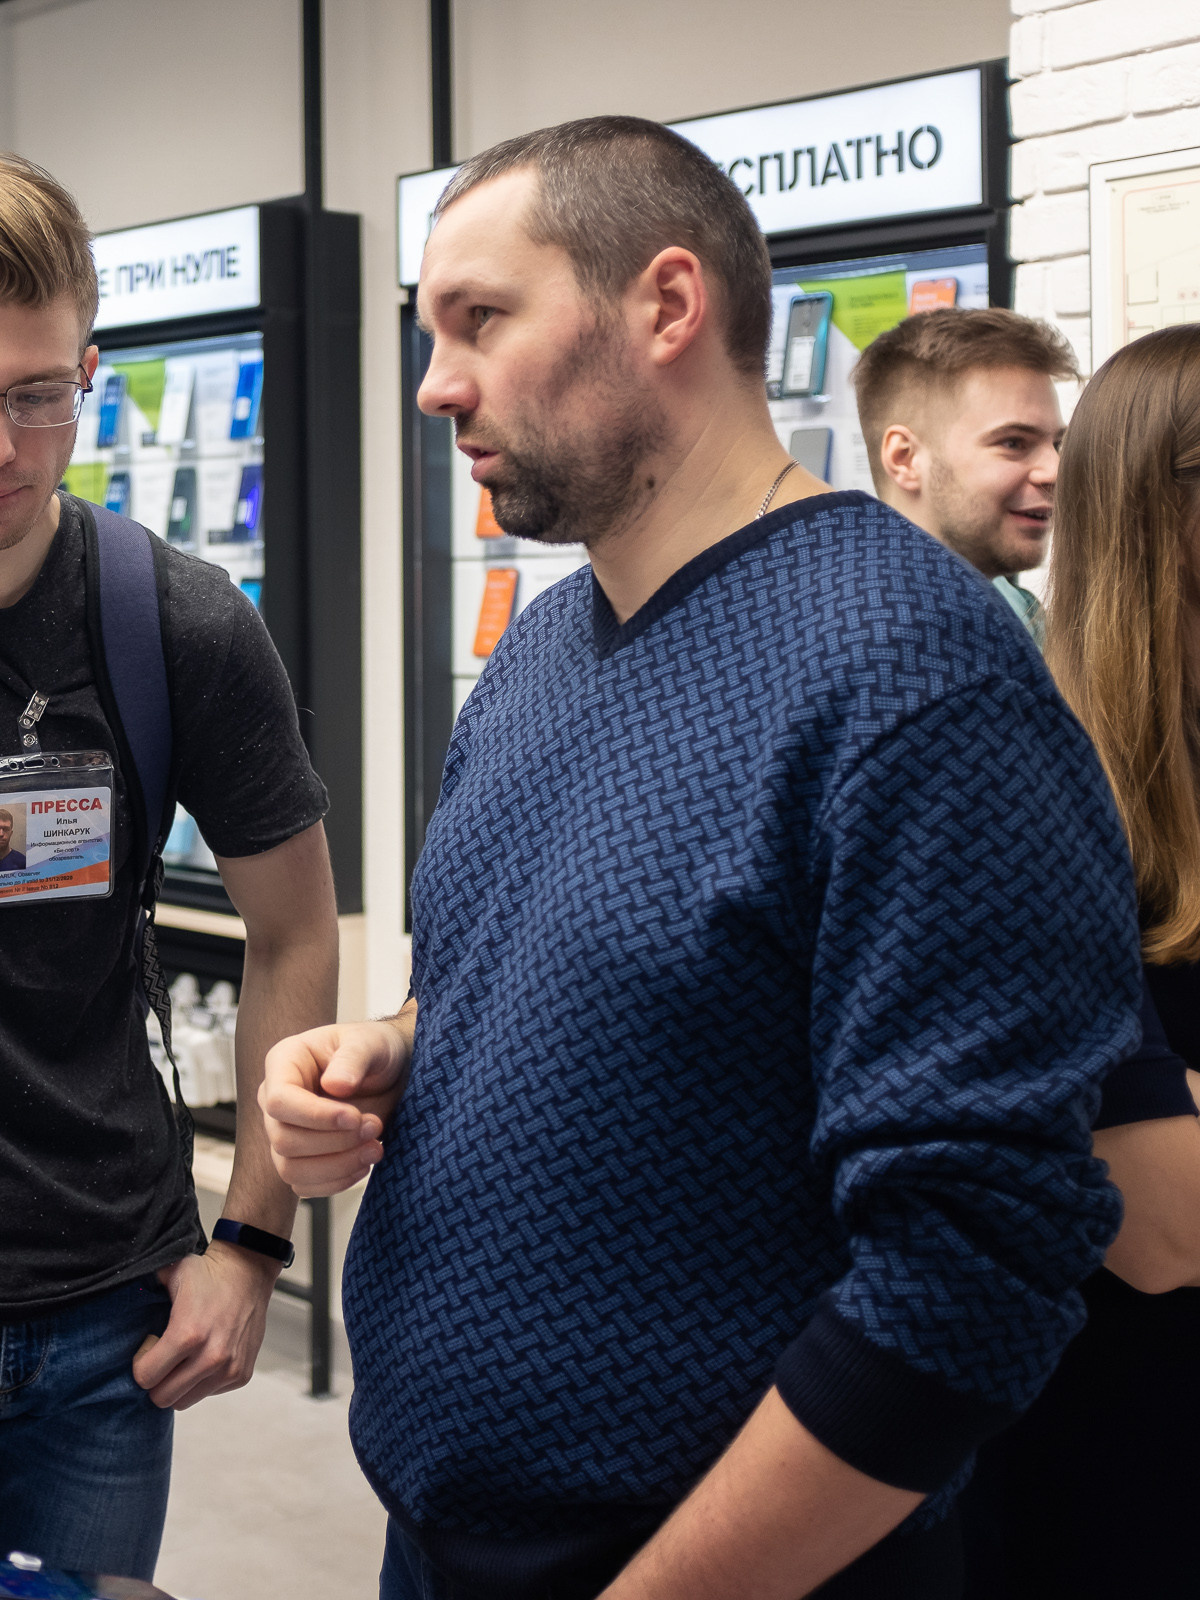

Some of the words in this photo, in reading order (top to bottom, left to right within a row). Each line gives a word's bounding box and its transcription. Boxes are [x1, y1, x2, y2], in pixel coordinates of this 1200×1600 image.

[717, 124, 943, 197] СПЛАТНО
[115, 257, 166, 296] ПРИ
[170, 246, 239, 287] НУЛЕ
[31, 797, 103, 815] ПРЕССА
[56, 817, 78, 825] Илья
[43, 828, 91, 838] ШИНКАРУК
